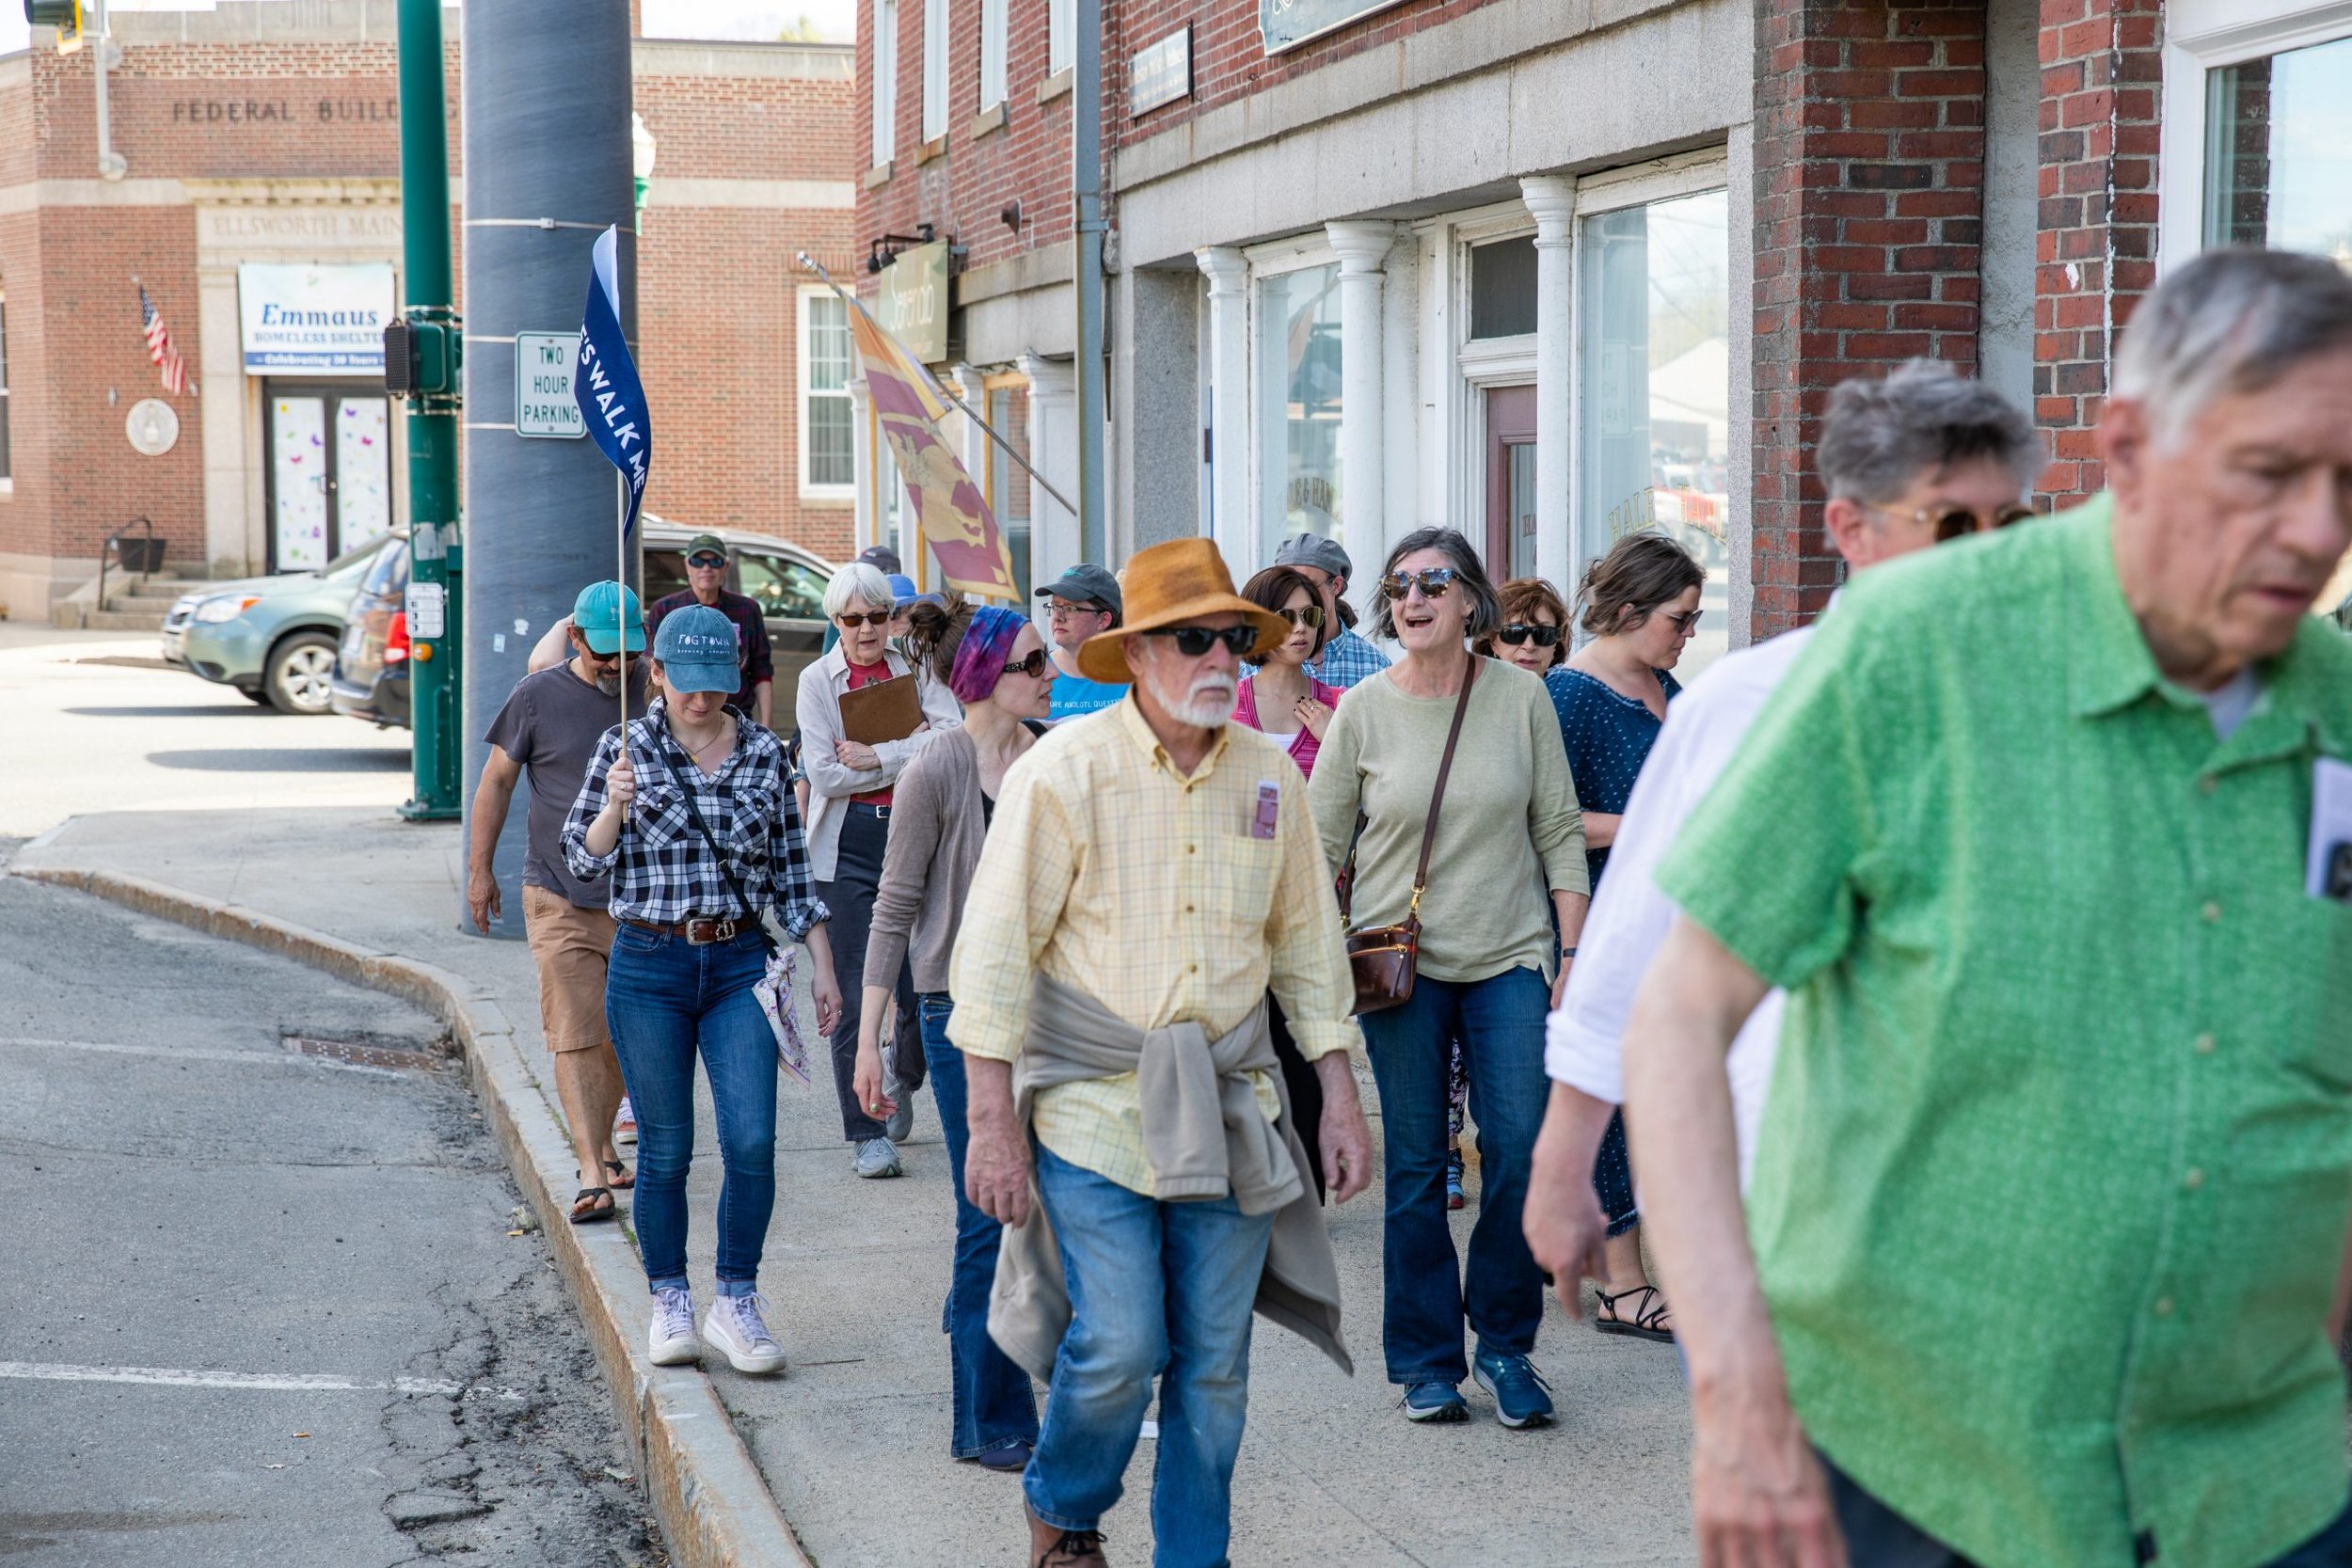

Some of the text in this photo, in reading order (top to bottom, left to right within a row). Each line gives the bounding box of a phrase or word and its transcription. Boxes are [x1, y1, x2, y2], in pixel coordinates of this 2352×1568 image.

[172, 98, 458, 123] FEDERAL BUILDG
[213, 214, 338, 237] ELLSWORTH
[262, 303, 378, 327] Emmaus
[254, 332, 327, 344] HOMELESS
[538, 345, 564, 366] TWO
[533, 375, 569, 394] HOUR
[524, 404, 580, 424] PARKING
[589, 359, 641, 450] WALK
[628, 449, 645, 495] ME
[1609, 485, 1656, 543] HALE
